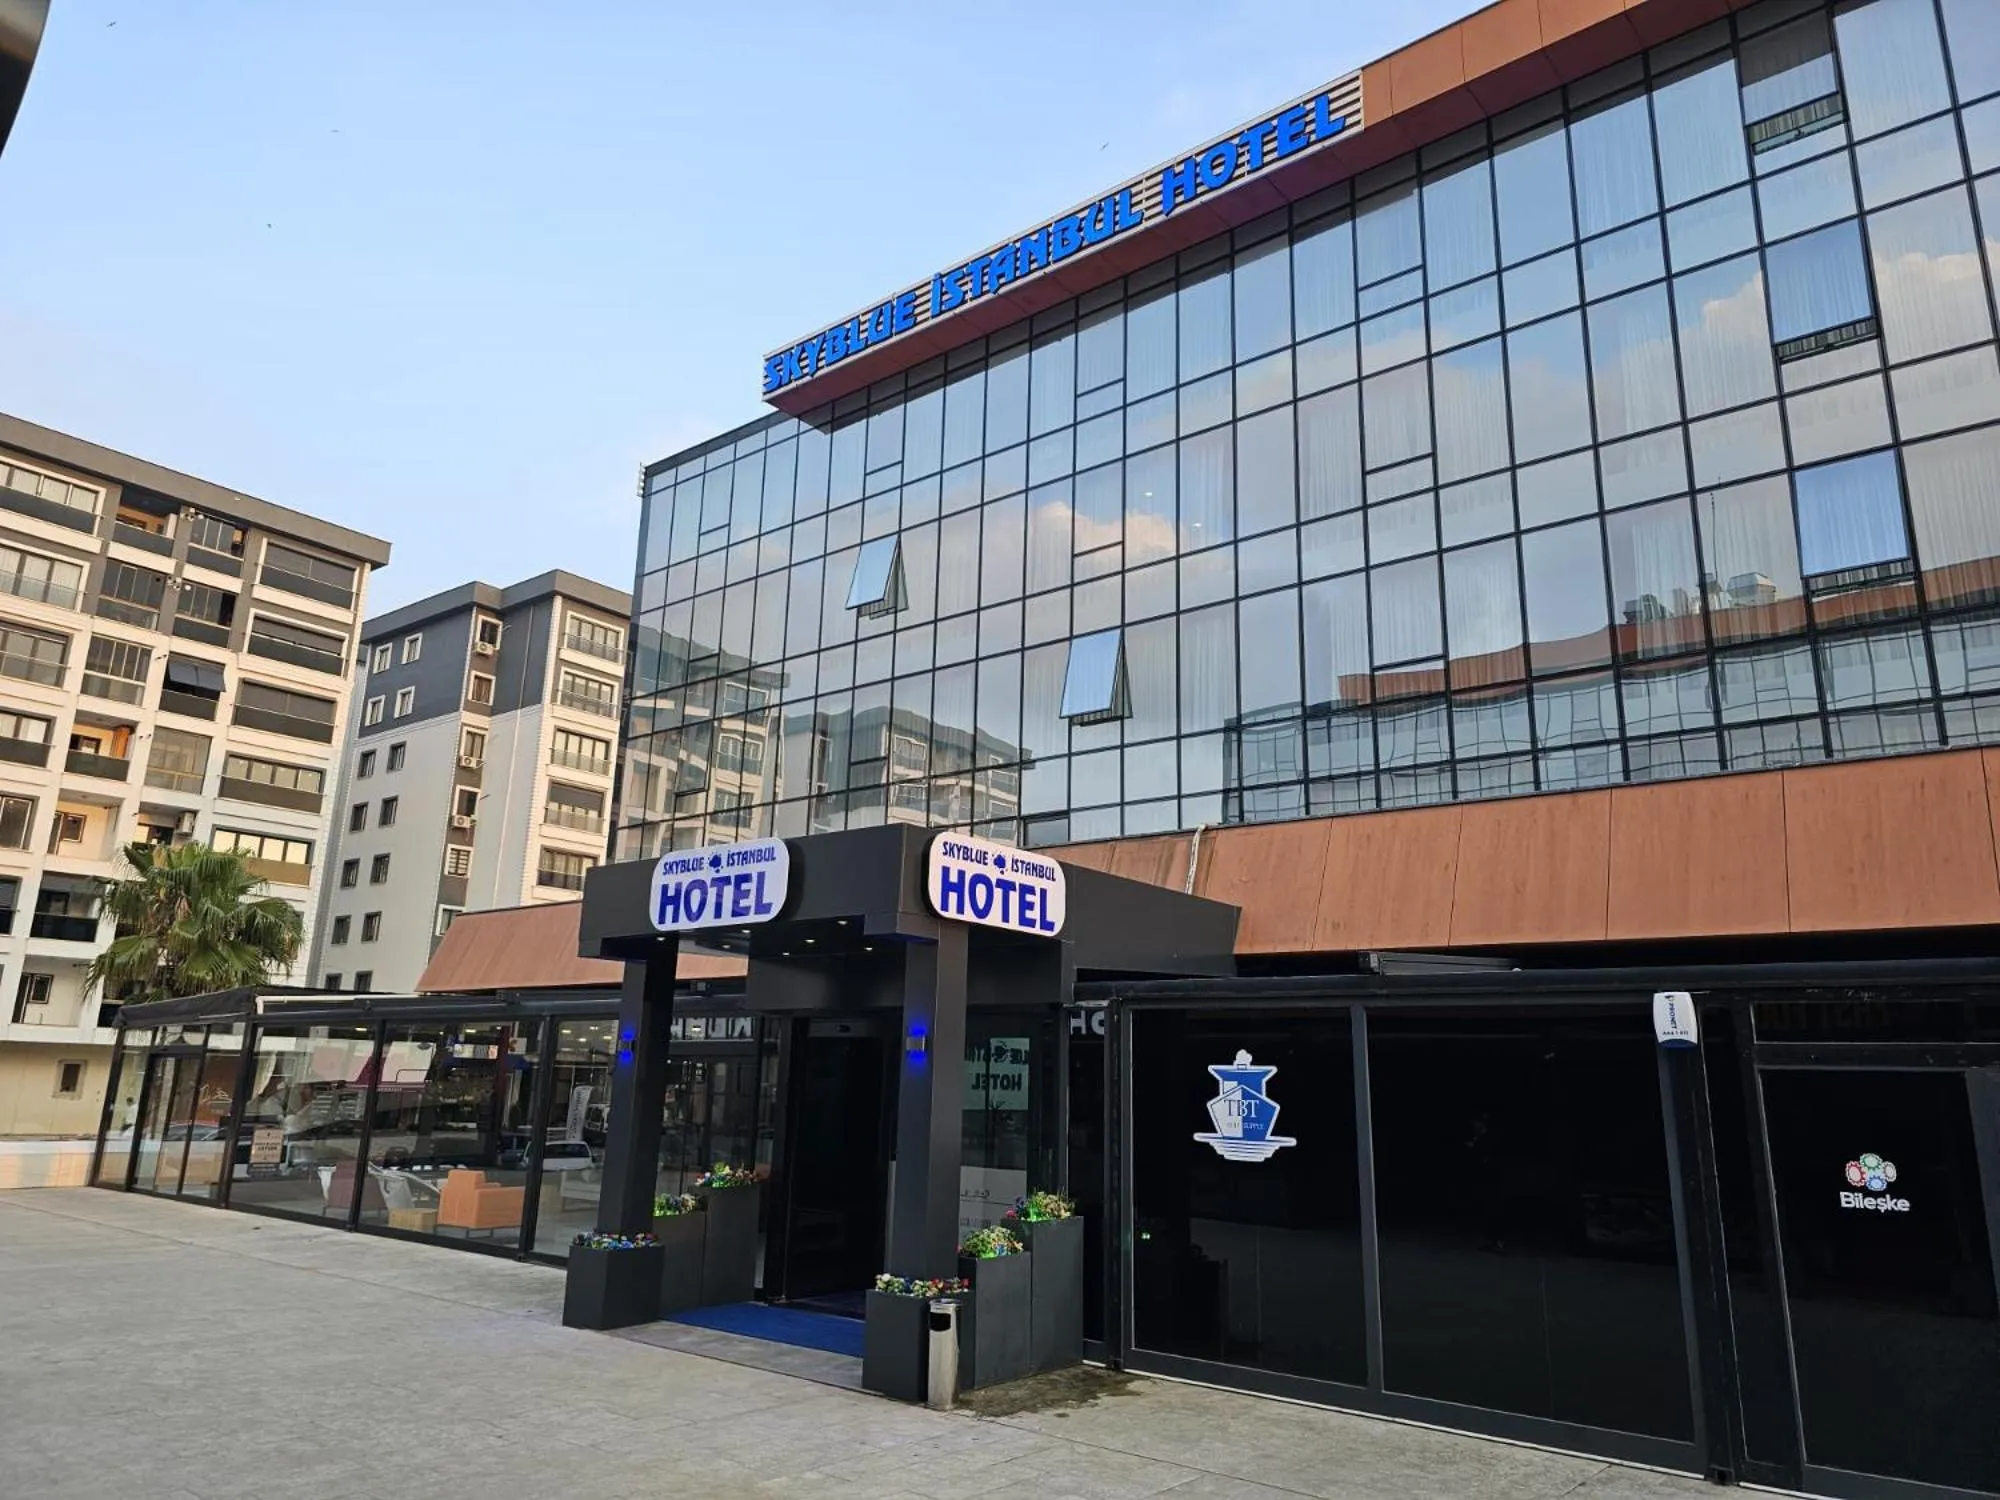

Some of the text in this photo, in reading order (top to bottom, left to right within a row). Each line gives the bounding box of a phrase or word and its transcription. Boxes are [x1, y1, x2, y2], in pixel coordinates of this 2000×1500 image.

[764, 95, 1346, 391] SKYBLUE İSTANBUL HOTEL
[662, 846, 777, 876] SKYBLUE İSTANBUL
[942, 841, 1057, 882] SKYBLUE İSTANBUL
[657, 871, 774, 925] HOTEL
[940, 865, 1056, 932] HOTEL
[1224, 1099, 1260, 1118] TBT
[1839, 1191, 1911, 1213] Bileşke
